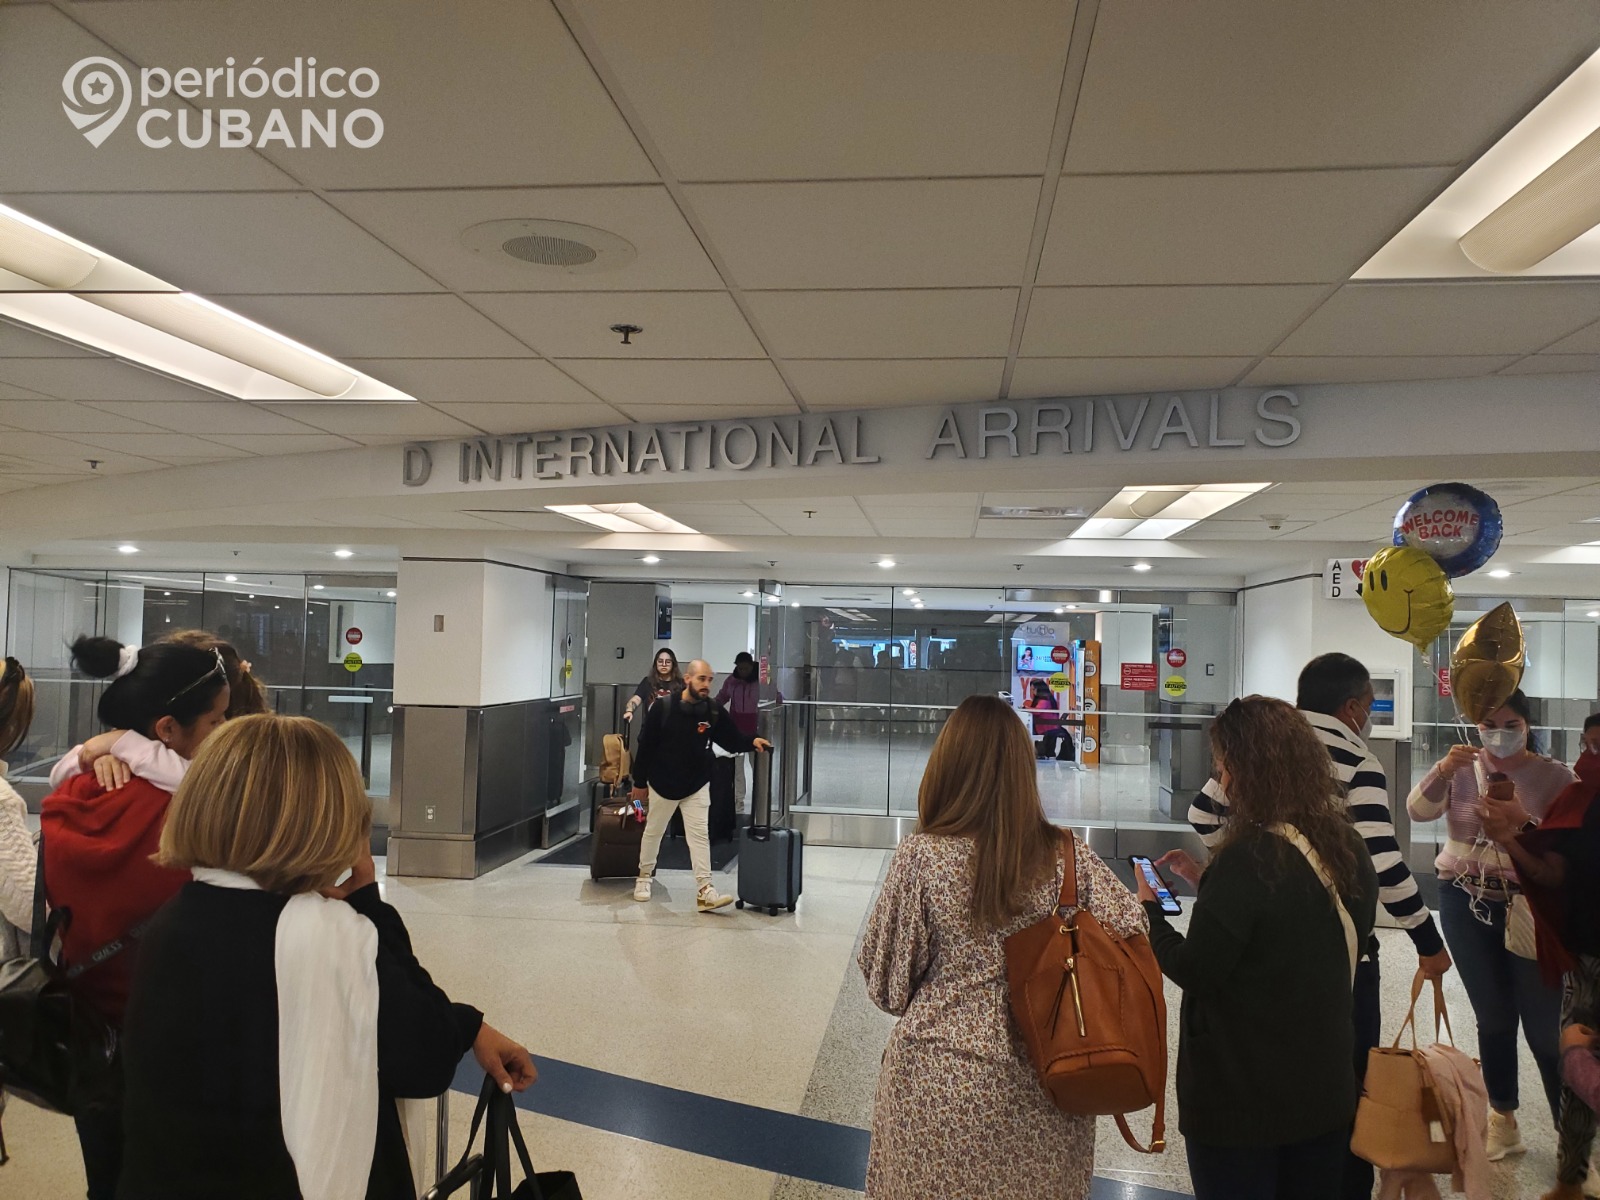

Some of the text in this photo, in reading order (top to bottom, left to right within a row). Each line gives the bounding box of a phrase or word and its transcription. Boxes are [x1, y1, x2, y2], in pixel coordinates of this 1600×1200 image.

[403, 389, 1301, 487] D INTERNATIONAL ARRIVALS
[1402, 509, 1480, 535] WELCOME
[1419, 523, 1463, 540] BACK
[92, 939, 123, 962] GUESS
